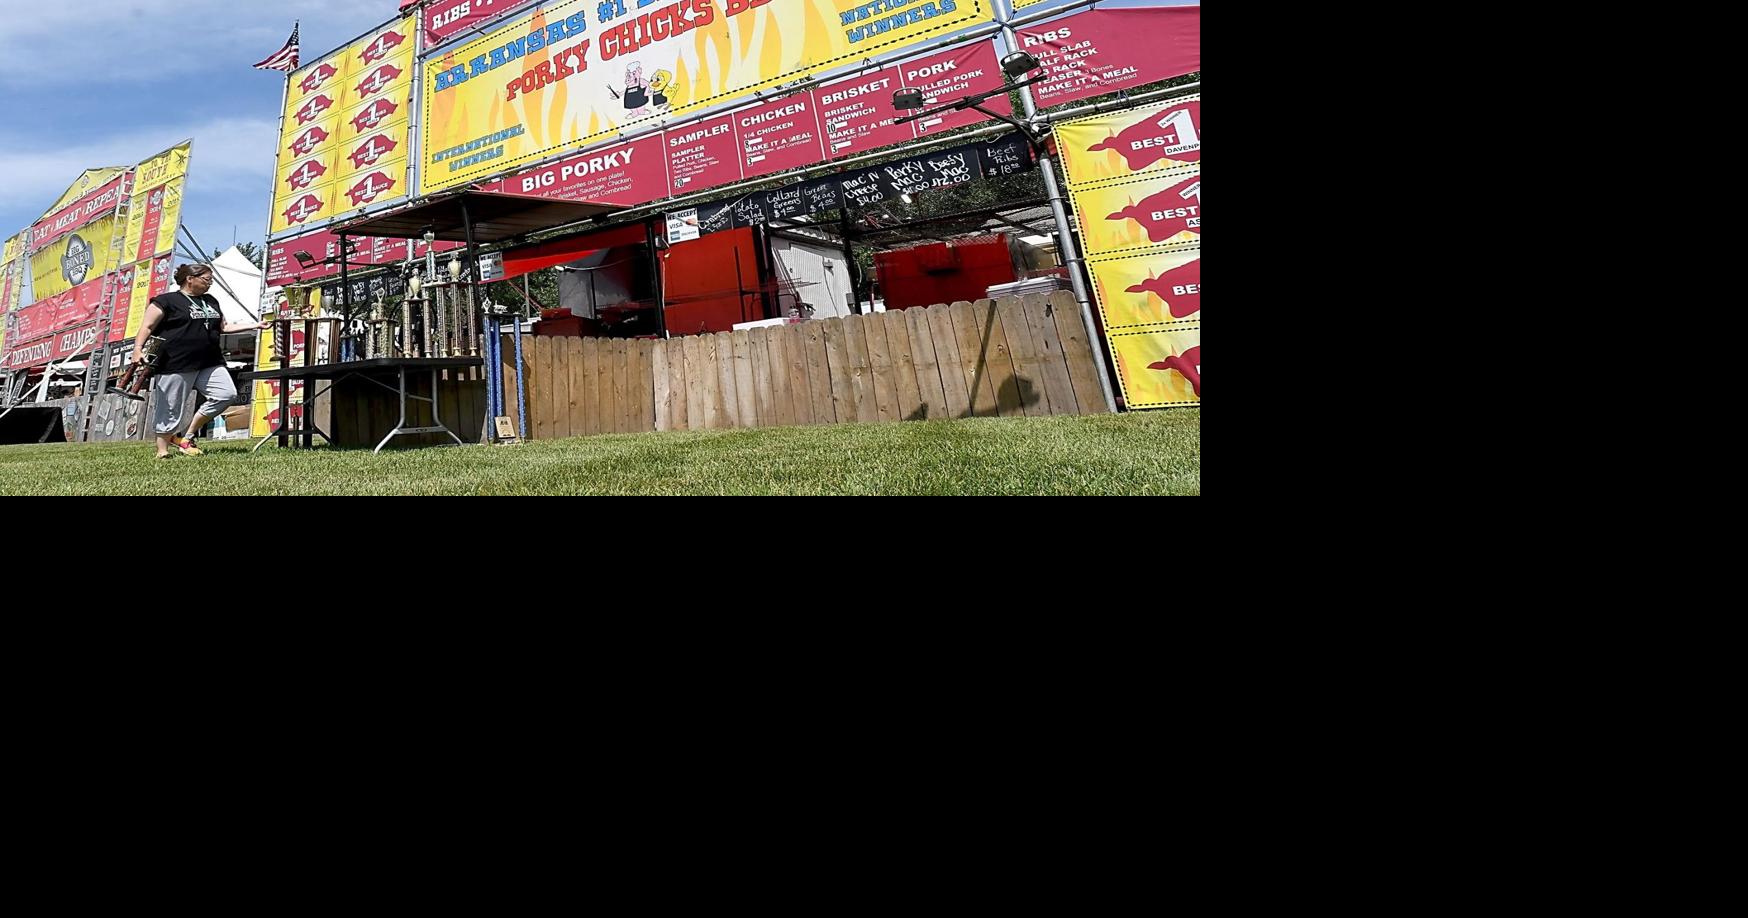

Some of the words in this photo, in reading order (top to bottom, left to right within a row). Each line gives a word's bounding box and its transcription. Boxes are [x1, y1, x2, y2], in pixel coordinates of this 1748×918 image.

[432, 0, 471, 30] RIBS
[846, 0, 957, 43] WINNERS
[374, 36, 387, 58] 1
[1023, 27, 1071, 48] RIBS
[1060, 40, 1092, 54] SLAB
[434, 10, 587, 92] ARKANSAS
[506, 38, 590, 102] PORKY
[599, 0, 714, 61] CHICKS
[1040, 56, 1060, 67] ALF
[1063, 48, 1098, 61] RACK
[907, 60, 957, 81] PORK
[953, 69, 984, 82] PORK
[1053, 60, 1087, 73] RACK
[1090, 64, 1114, 72] Bones
[312, 68, 322, 88] 1
[371, 69, 384, 91] 1
[1038, 82, 1073, 95] MAKE
[1102, 66, 1138, 79] MEAL
[1099, 73, 1137, 86] Cornbread
[822, 78, 890, 105] BRISKET
[921, 82, 969, 99] ANDWICH
[308, 99, 318, 119] 1
[367, 103, 380, 126] 1
[741, 102, 806, 127] CHICKEN
[824, 102, 865, 117] BRISKET
[826, 107, 876, 125] SANDWICH
[670, 124, 730, 147] SAMPLER
[756, 121, 794, 136] CHICKEN
[789, 132, 813, 142] MEAL
[827, 124, 836, 133] 10
[830, 128, 856, 140] MAKE
[1131, 133, 1176, 151] BEST
[1157, 109, 1200, 155] 1
[302, 130, 313, 151] 1
[365, 139, 379, 162] 1
[431, 123, 524, 164] INTERNATIONAL
[987, 143, 1017, 158] Beef
[449, 144, 503, 172] WINNERS
[672, 145, 705, 158] SAMPLER
[672, 152, 705, 165] PLATTER
[993, 155, 1019, 164] Ribs
[299, 164, 311, 185] 1
[522, 171, 555, 192] BIG
[561, 147, 634, 181] PORKY
[940, 166, 969, 179] Mac
[361, 176, 377, 200] 1
[563, 181, 586, 192] favorites
[609, 171, 625, 181] plate!
[675, 179, 684, 188] 20
[767, 186, 800, 203] Collard
[773, 198, 801, 209] Greens
[811, 191, 836, 203] Beans
[856, 192, 884, 206] $4.00
[296, 198, 308, 219] 1
[678, 209, 697, 218] ACCEPT
[738, 208, 764, 221] Salad
[1151, 205, 1198, 221] BEST
[33, 225, 51, 242] EAT
[53, 207, 83, 233] MEAT
[669, 222, 684, 230] VISA
[65, 251, 91, 271] BONED
[11, 342, 52, 366] DEFENDING
